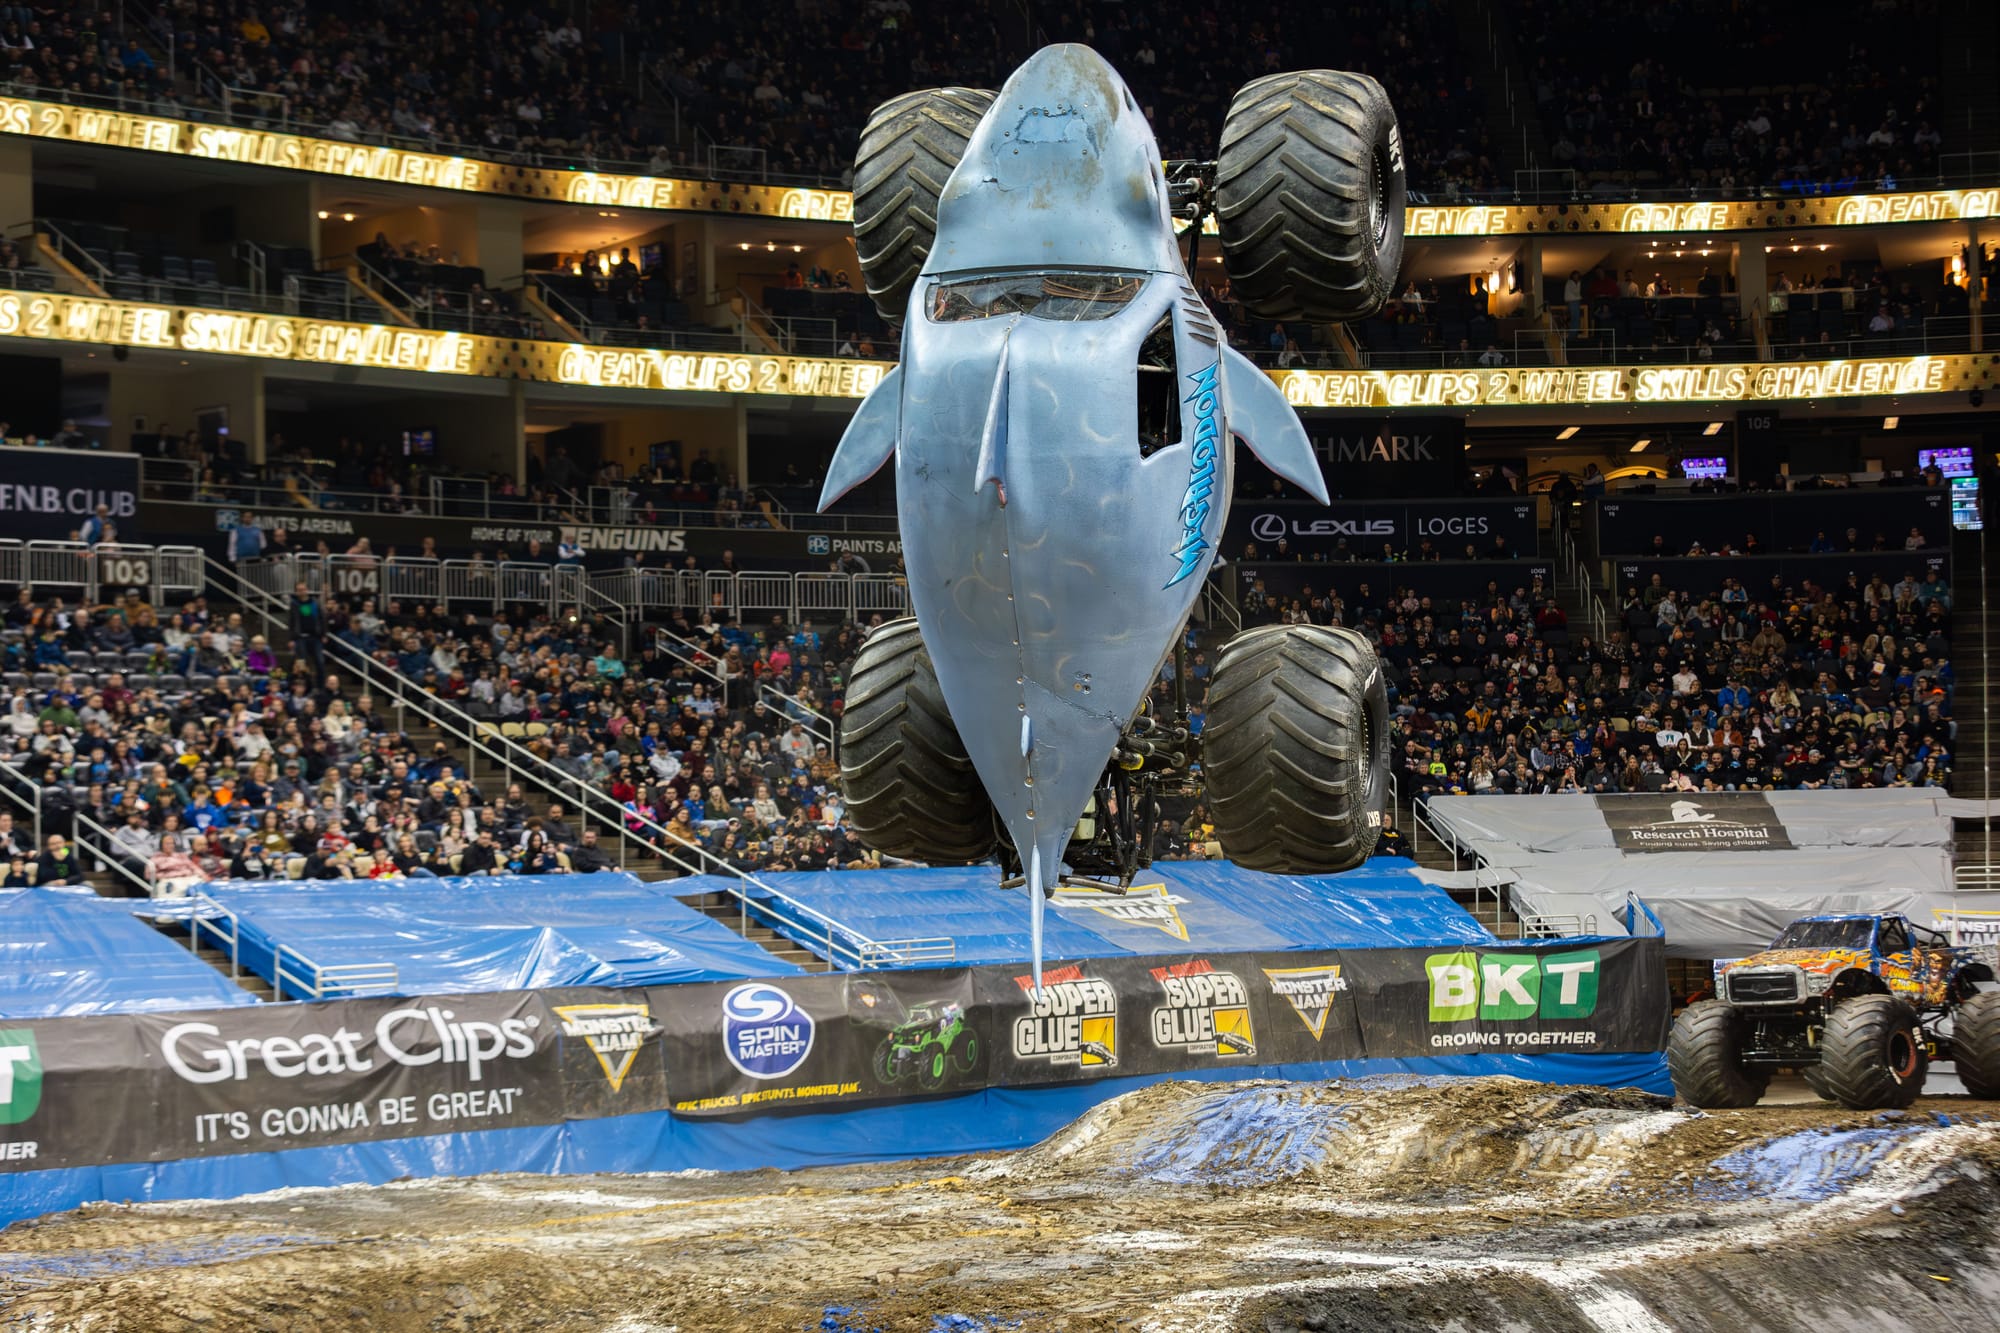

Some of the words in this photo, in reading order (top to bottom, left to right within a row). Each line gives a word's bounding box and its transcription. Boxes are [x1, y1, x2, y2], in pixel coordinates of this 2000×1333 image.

[40, 108, 64, 137] 2
[190, 127, 301, 169] SKILLS
[309, 142, 479, 191] CHALLENGE
[1388, 125, 1404, 173] BKT
[1836, 194, 1951, 225] GREAT
[26, 299, 54, 336] 2
[65, 302, 175, 347] WHEEL
[181, 312, 294, 357] SKILLS
[301, 323, 474, 374] CHALLENGE
[558, 350, 652, 387] GREAT
[661, 355, 750, 393] CLIPS
[757, 361, 780, 393] 2
[1281, 374, 1381, 406] GREAT
[1387, 374, 1478, 406] CLIPS
[1487, 374, 1510, 404] 2
[1520, 369, 1626, 403] WHEEL
[1635, 367, 1746, 402] SKILLS
[1755, 359, 1945, 400] CHALLENGE
[1747, 416, 1771, 430] 105
[1312, 434, 1434, 462] HMARK
[1162, 361, 1219, 590] MEGALODON
[67, 488, 136, 517] CLUB
[254, 515, 299, 532] AINTS
[301, 517, 354, 535] ARENA
[471, 526, 504, 541] HOME
[505, 527, 522, 542] OF
[523, 528, 553, 543] YOUR
[1293, 519, 1395, 536] LEXUS
[1418, 516, 1489, 536] LOGES
[832, 539, 884, 554] PAINTS
[104, 559, 149, 585] 103
[337, 569, 379, 593] 104
[1631, 829, 1700, 840] Research
[1704, 827, 1769, 840] Hospital
[1164, 974, 1247, 1009] SUPER
[1269, 976, 1348, 995] MONSTER
[1430, 960, 1595, 1008] BKT
[1029, 979, 1116, 1018] SUPER
[1295, 992, 1329, 1010] JAM
[738, 1024, 800, 1047] SPIN
[1017, 1016, 1080, 1055] GLUE
[1155, 1008, 1213, 1044] GLUE
[1504, 1031, 1597, 1046] TOGETHER
[161, 1022, 373, 1084] Great
[595, 1032, 640, 1053] JAM
[796, 1084, 839, 1098] MONSTER
[195, 1111, 251, 1143] IT'S
[260, 1102, 370, 1137] GONNA
[378, 1096, 418, 1126] BE
